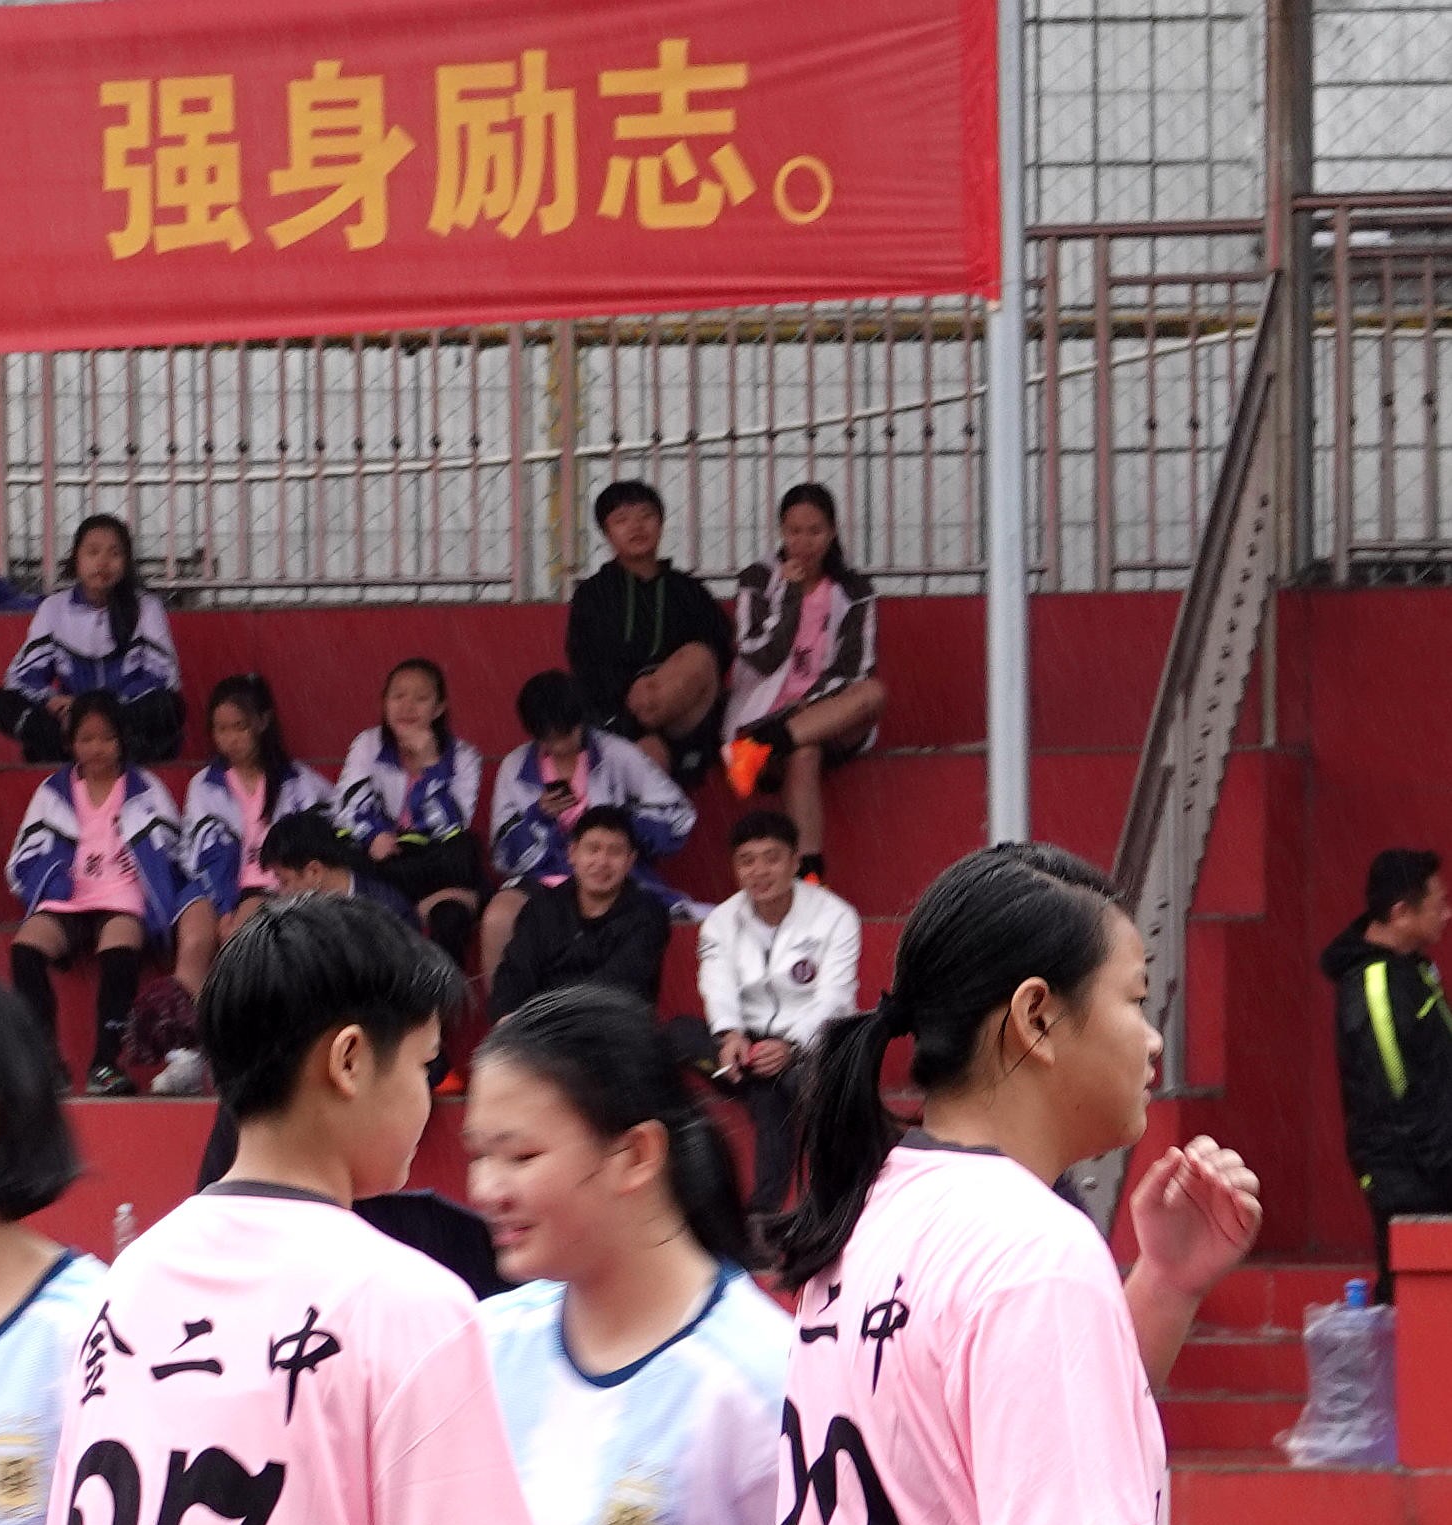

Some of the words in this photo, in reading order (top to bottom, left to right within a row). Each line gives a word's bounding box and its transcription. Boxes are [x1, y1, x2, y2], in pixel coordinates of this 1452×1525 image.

[79, 1299, 343, 1427] 金二中
[789, 1273, 910, 1395] 二中
